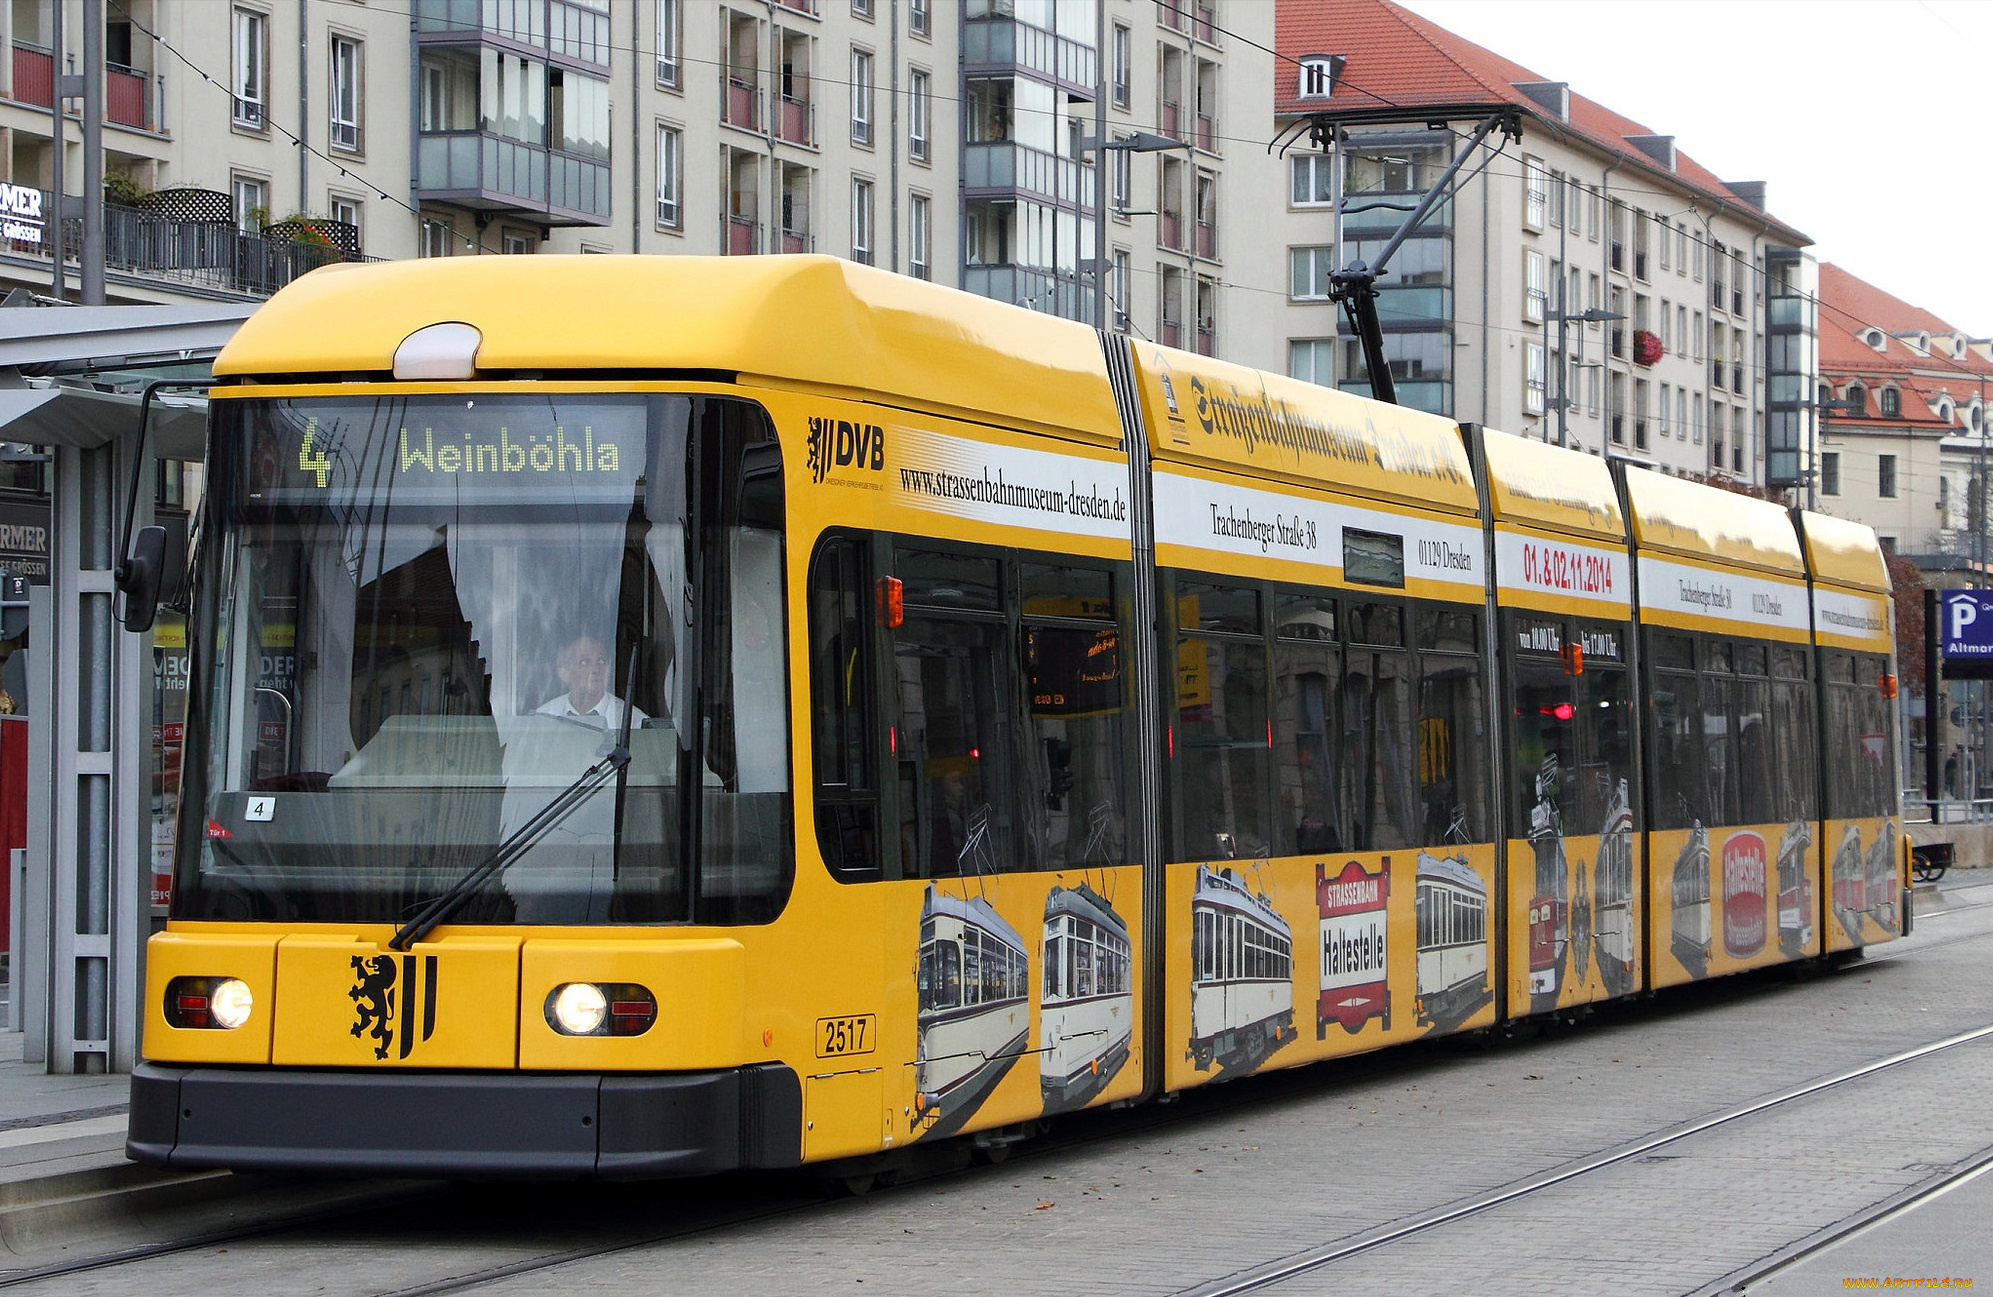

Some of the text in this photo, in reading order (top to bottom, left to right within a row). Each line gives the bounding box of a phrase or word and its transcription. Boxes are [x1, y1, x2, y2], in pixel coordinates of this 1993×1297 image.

[299, 417, 619, 488] 4 Weinböhla
[836, 420, 885, 471] DVB
[900, 465, 1126, 522] www.strassenbahnmuseum-dresden.de
[1210, 503, 1317, 552] Trachenberger Straße 38
[1418, 539, 1471, 571] 01129 Dresden
[1953, 603, 1977, 639] P
[254, 802, 264, 817] 4
[209, 829, 221, 837] Tür
[1327, 879, 1379, 909] STRASSENBAHN
[1323, 922, 1383, 977] Haltestelle
[826, 1019, 867, 1053] 2517
